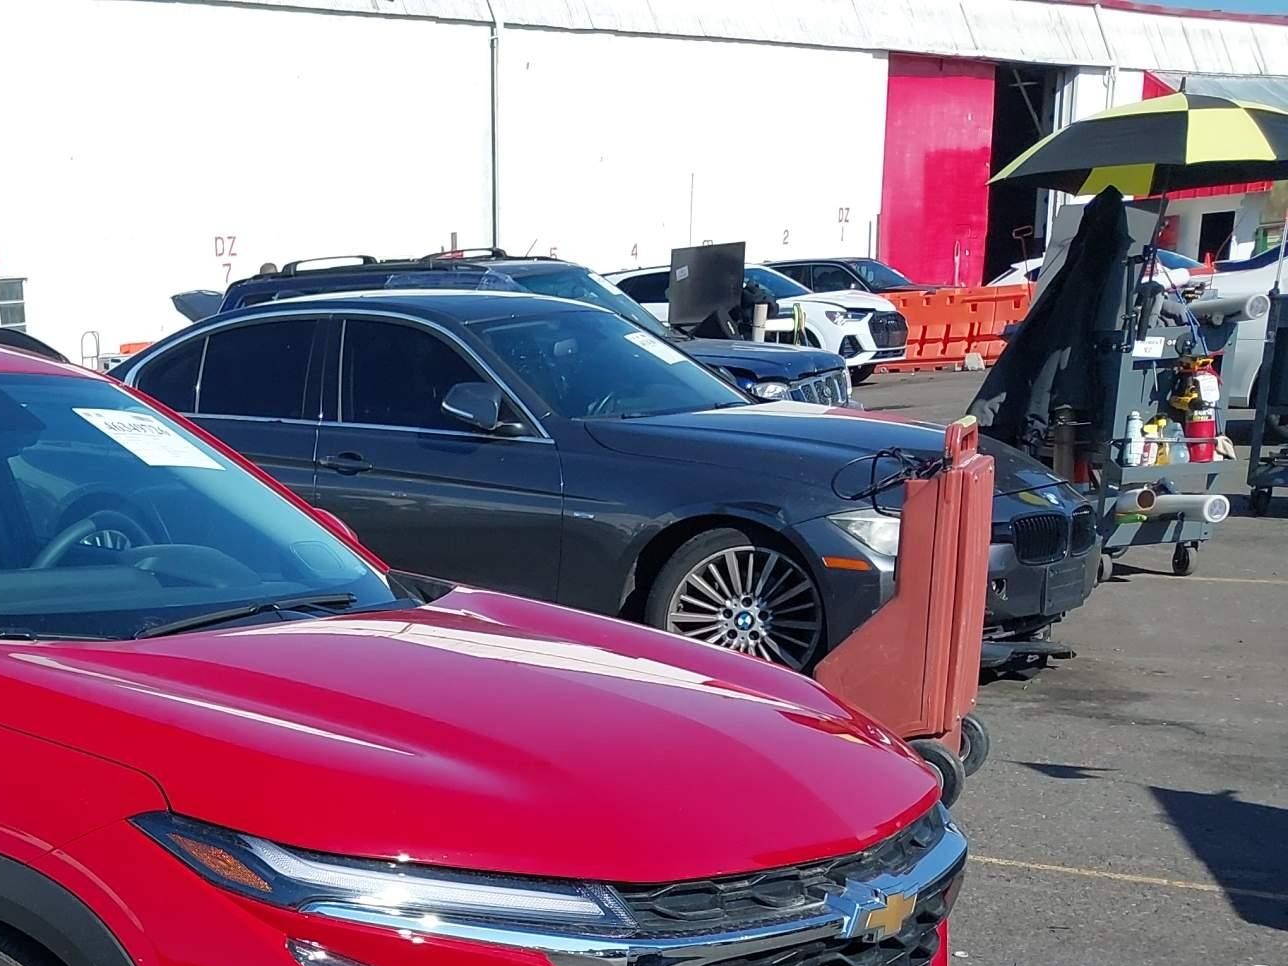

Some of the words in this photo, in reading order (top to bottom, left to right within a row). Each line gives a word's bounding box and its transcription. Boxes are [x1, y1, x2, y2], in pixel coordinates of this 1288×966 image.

[214, 236, 238, 257] DZ
[782, 229, 790, 245] 2
[630, 243, 638, 260] 4
[222, 263, 231, 284] 7
